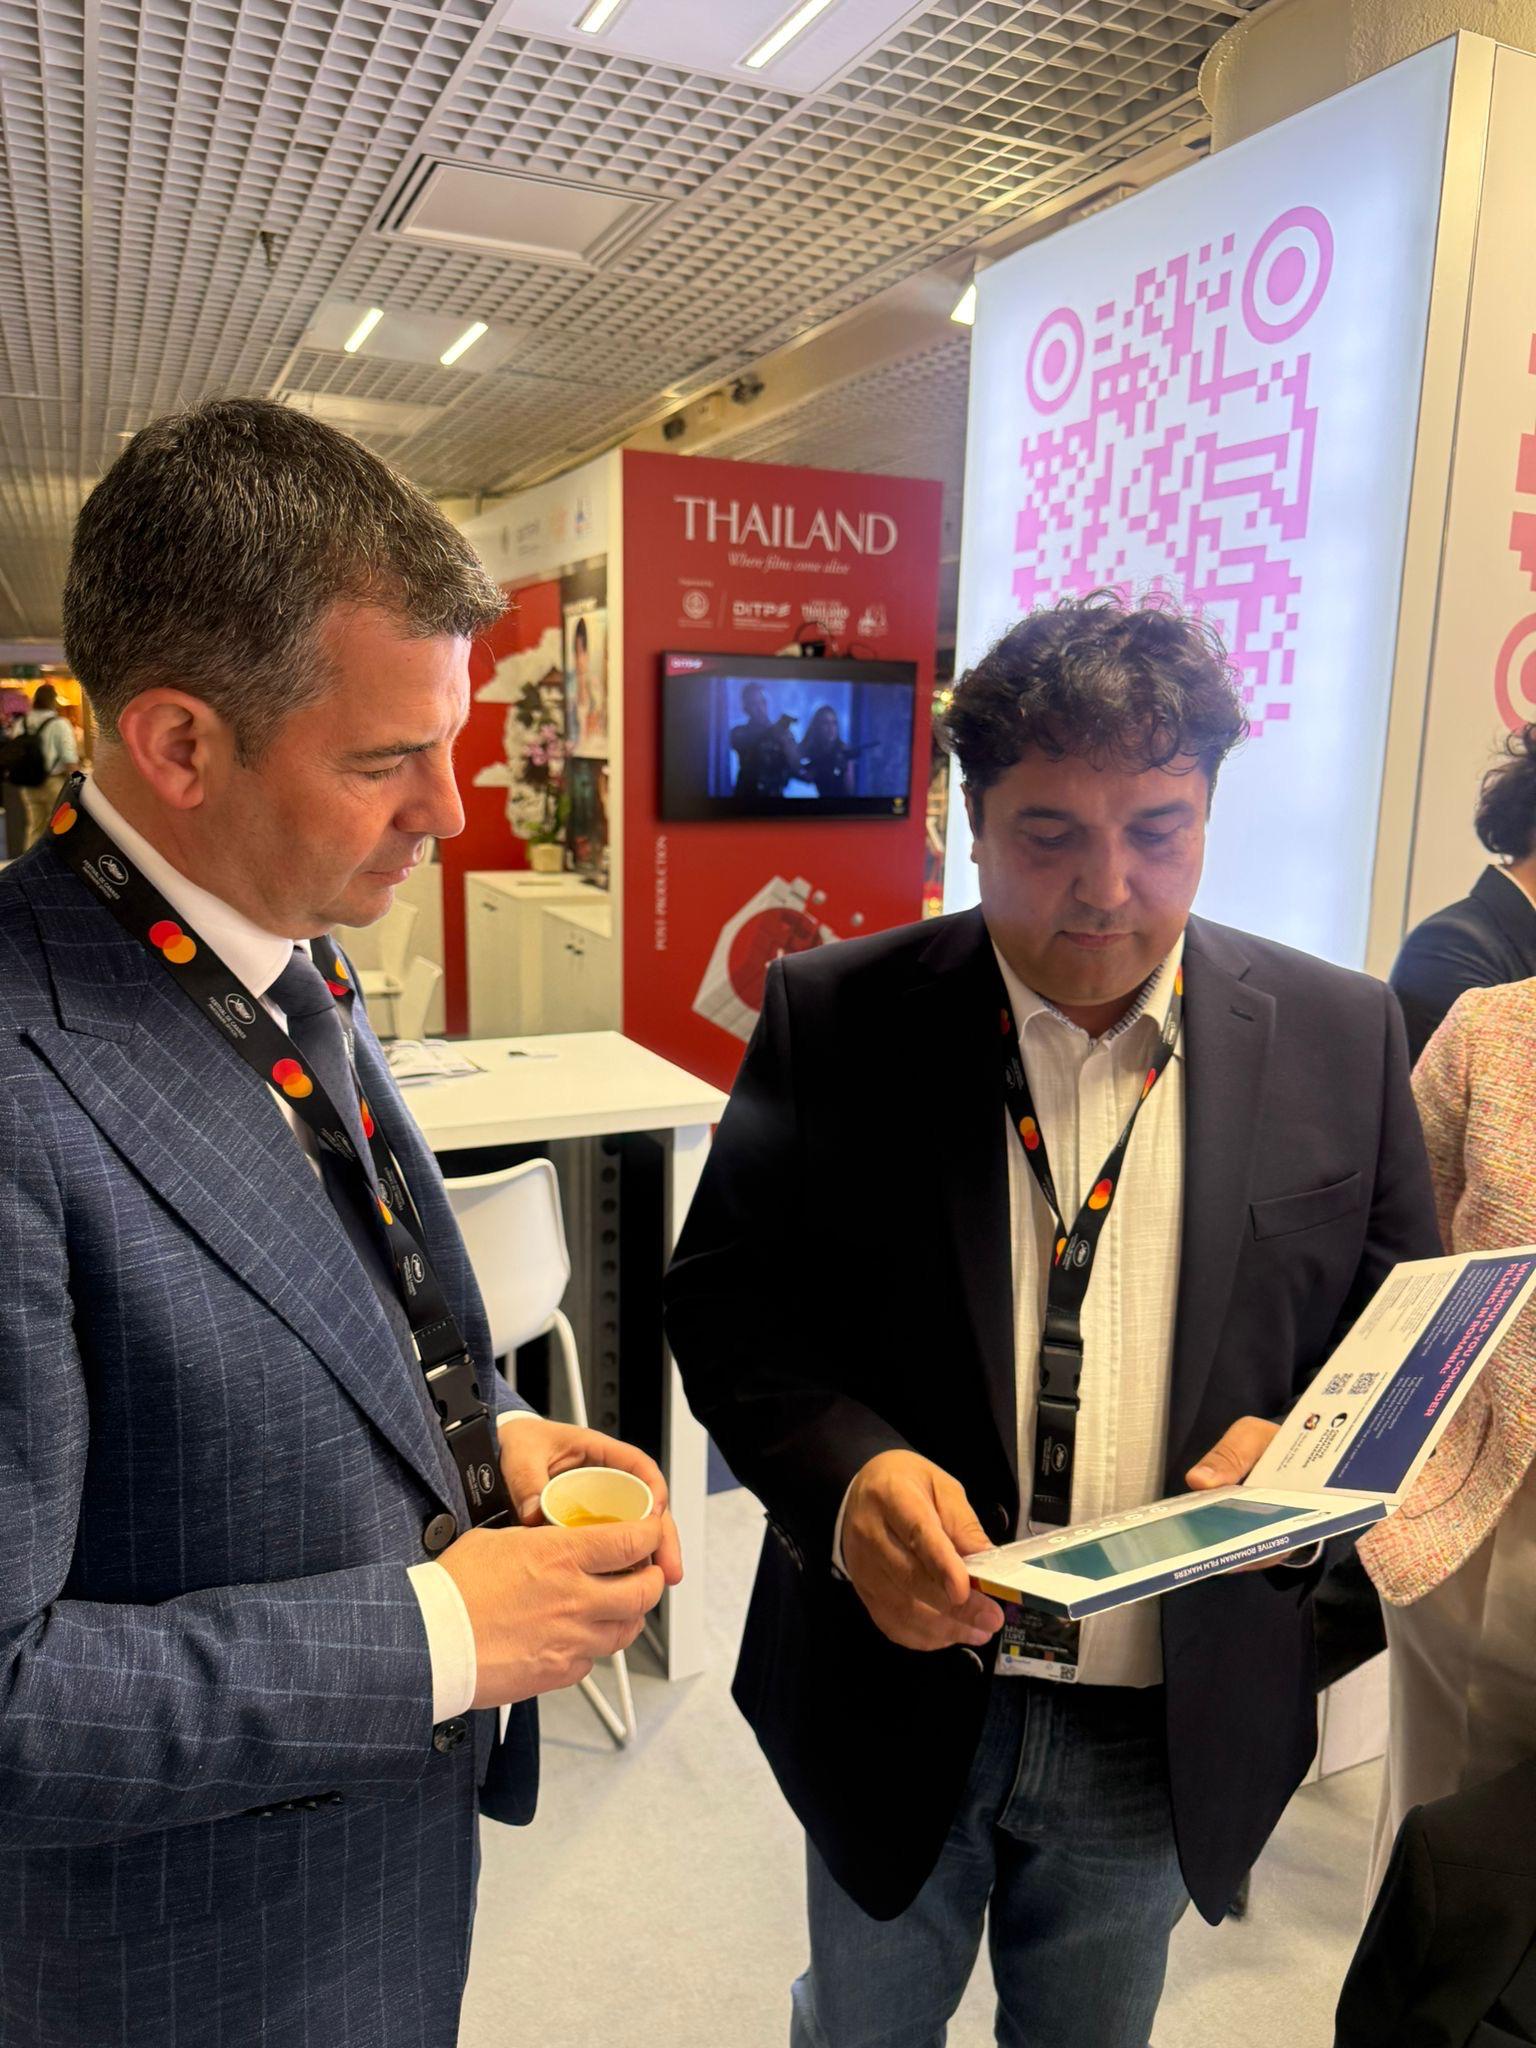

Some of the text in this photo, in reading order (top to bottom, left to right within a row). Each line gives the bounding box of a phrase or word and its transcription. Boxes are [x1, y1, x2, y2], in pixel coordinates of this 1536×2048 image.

[673, 494, 898, 556] THAILAND
[1484, 1263, 1518, 1303] FILMING
[1510, 1261, 1531, 1287] WHY
[1474, 1306, 1490, 1318] IN
[1478, 1287, 1513, 1332] SHOULD
[1439, 1320, 1480, 1374] ROMANIA:
[1462, 1334, 1483, 1356] YOU
[1423, 1358, 1466, 1417] CONSIDER
[1173, 1536, 1289, 1579] CREATIVE ROMANIAN FILM MAKERS
